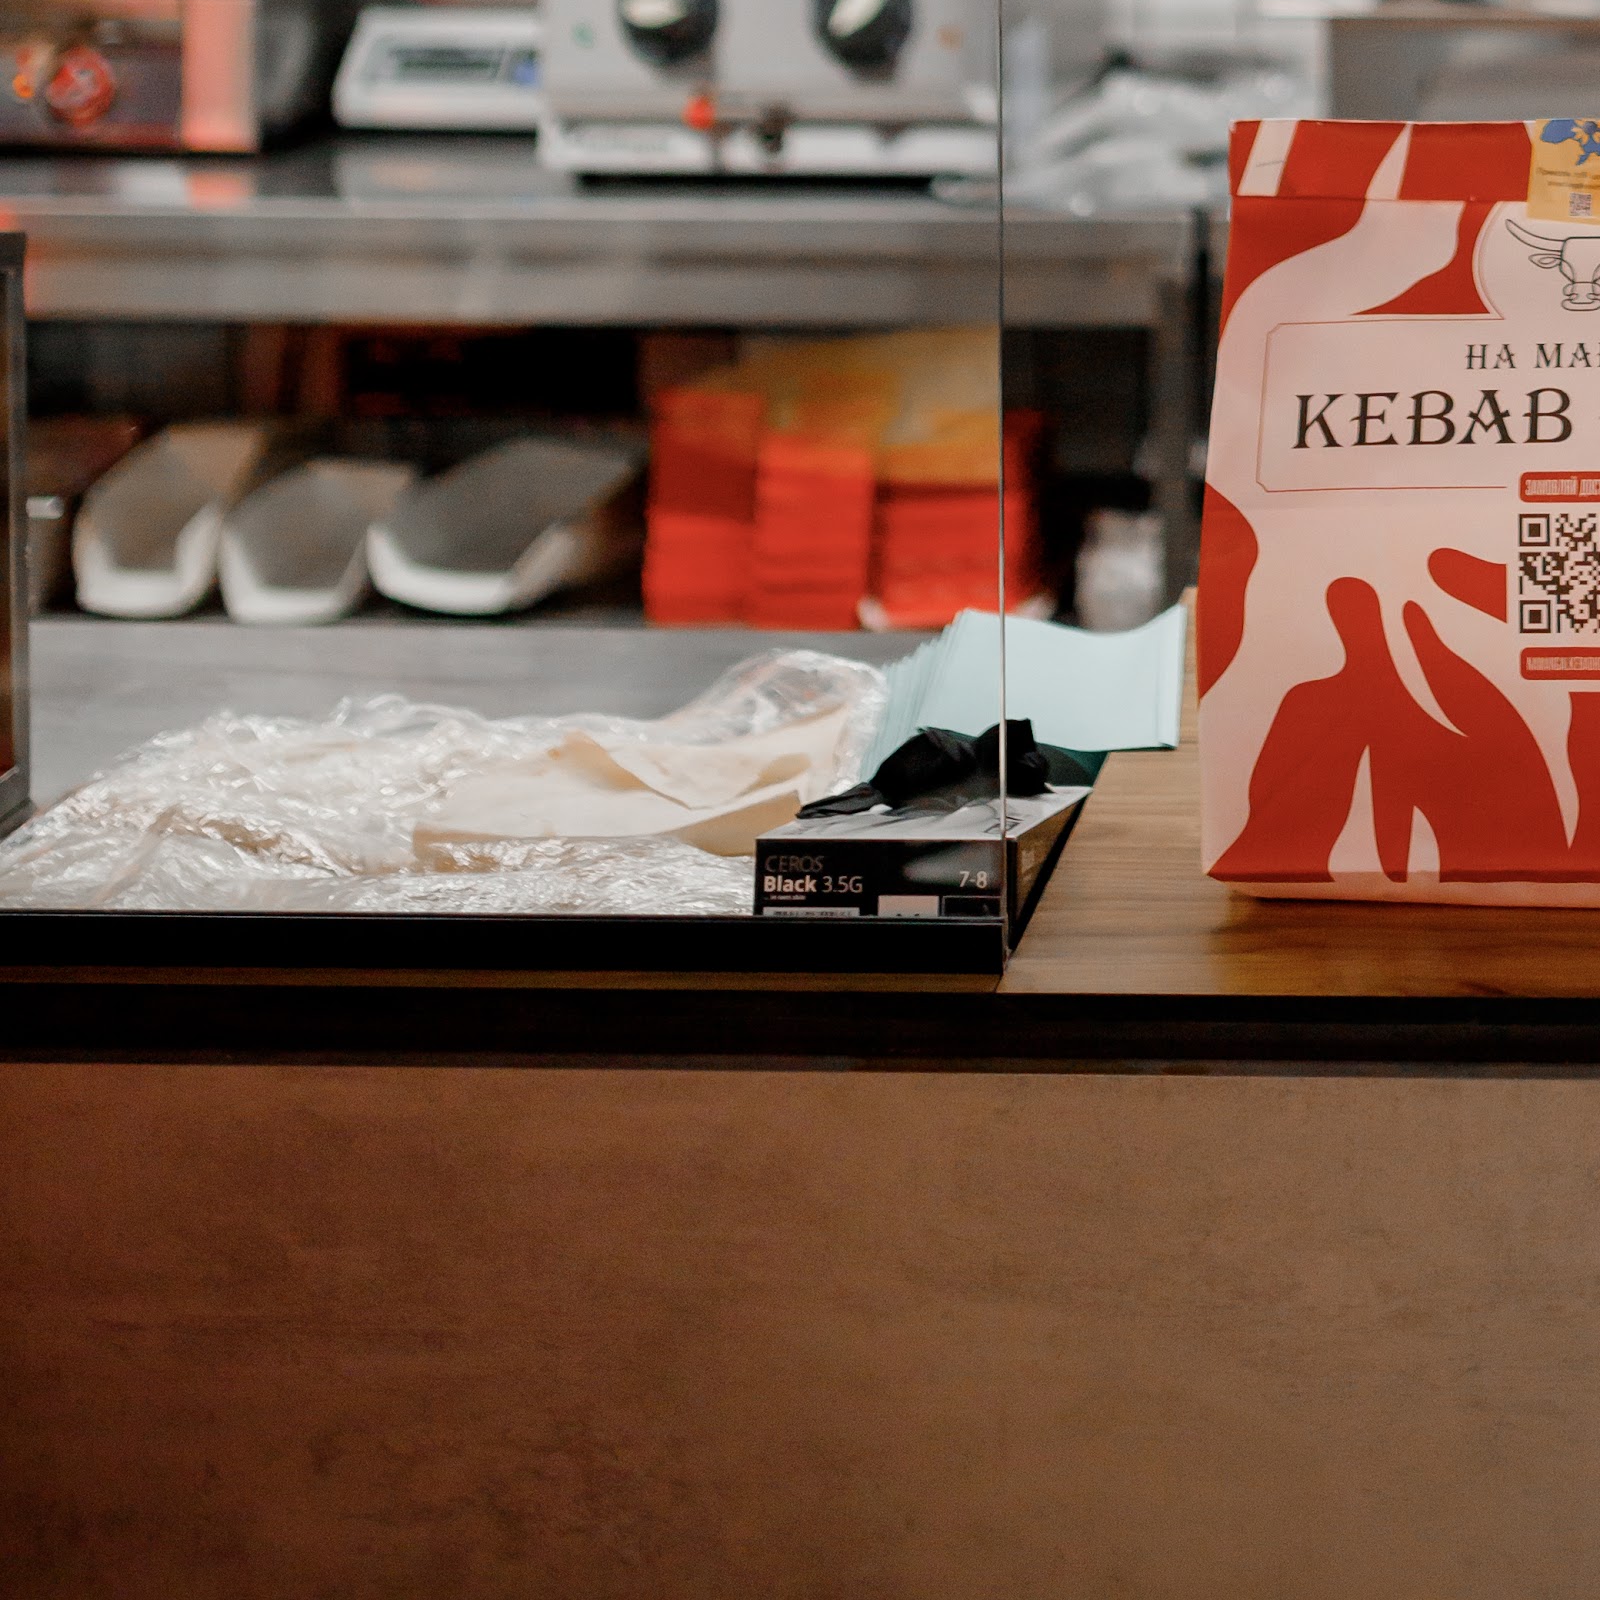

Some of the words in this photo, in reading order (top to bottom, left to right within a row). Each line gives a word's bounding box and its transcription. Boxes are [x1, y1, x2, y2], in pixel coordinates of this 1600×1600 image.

[1465, 343, 1516, 370] НА
[1292, 391, 1573, 450] KEBAB
[763, 874, 817, 893] Black
[822, 876, 864, 894] 3.5G
[959, 870, 988, 889] 7-8
